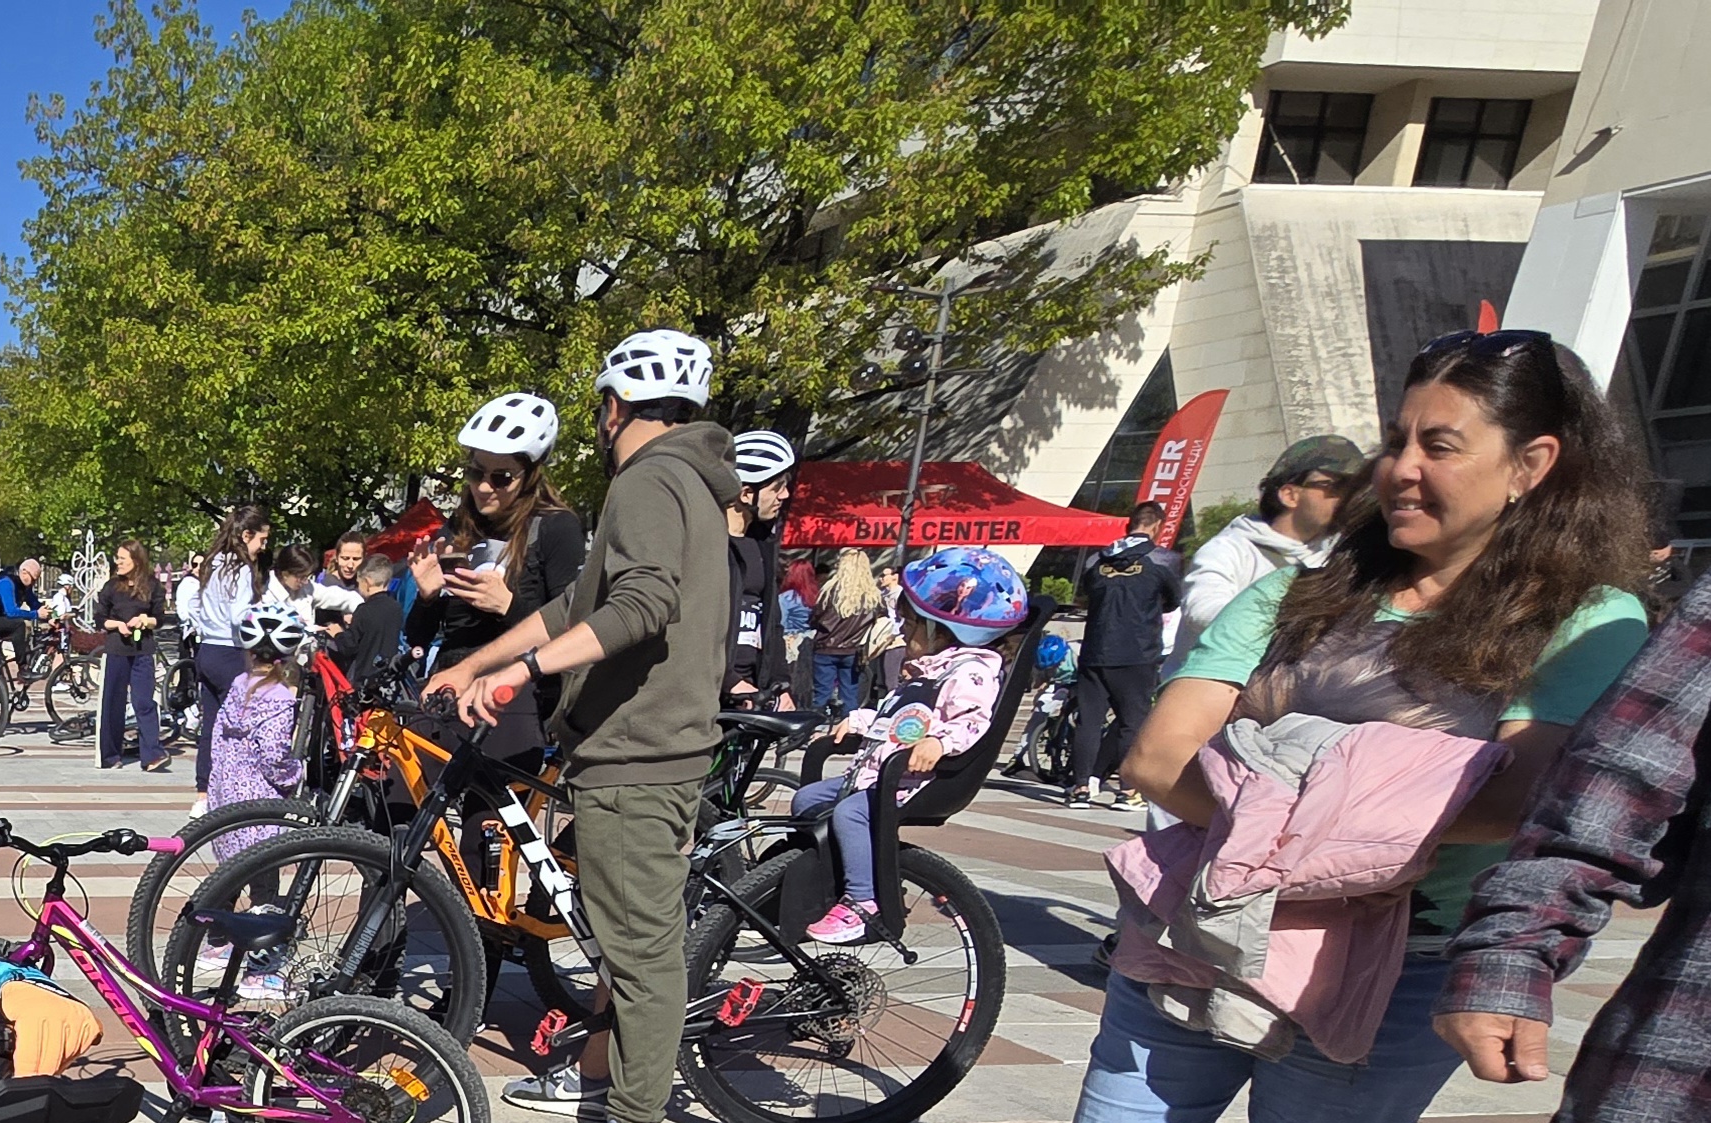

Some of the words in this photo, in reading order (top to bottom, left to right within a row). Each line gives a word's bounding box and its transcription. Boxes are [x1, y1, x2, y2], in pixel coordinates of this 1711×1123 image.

[1147, 439, 1188, 511] TER
[921, 519, 1023, 542] CENTER
[444, 840, 476, 897] MERIDA
